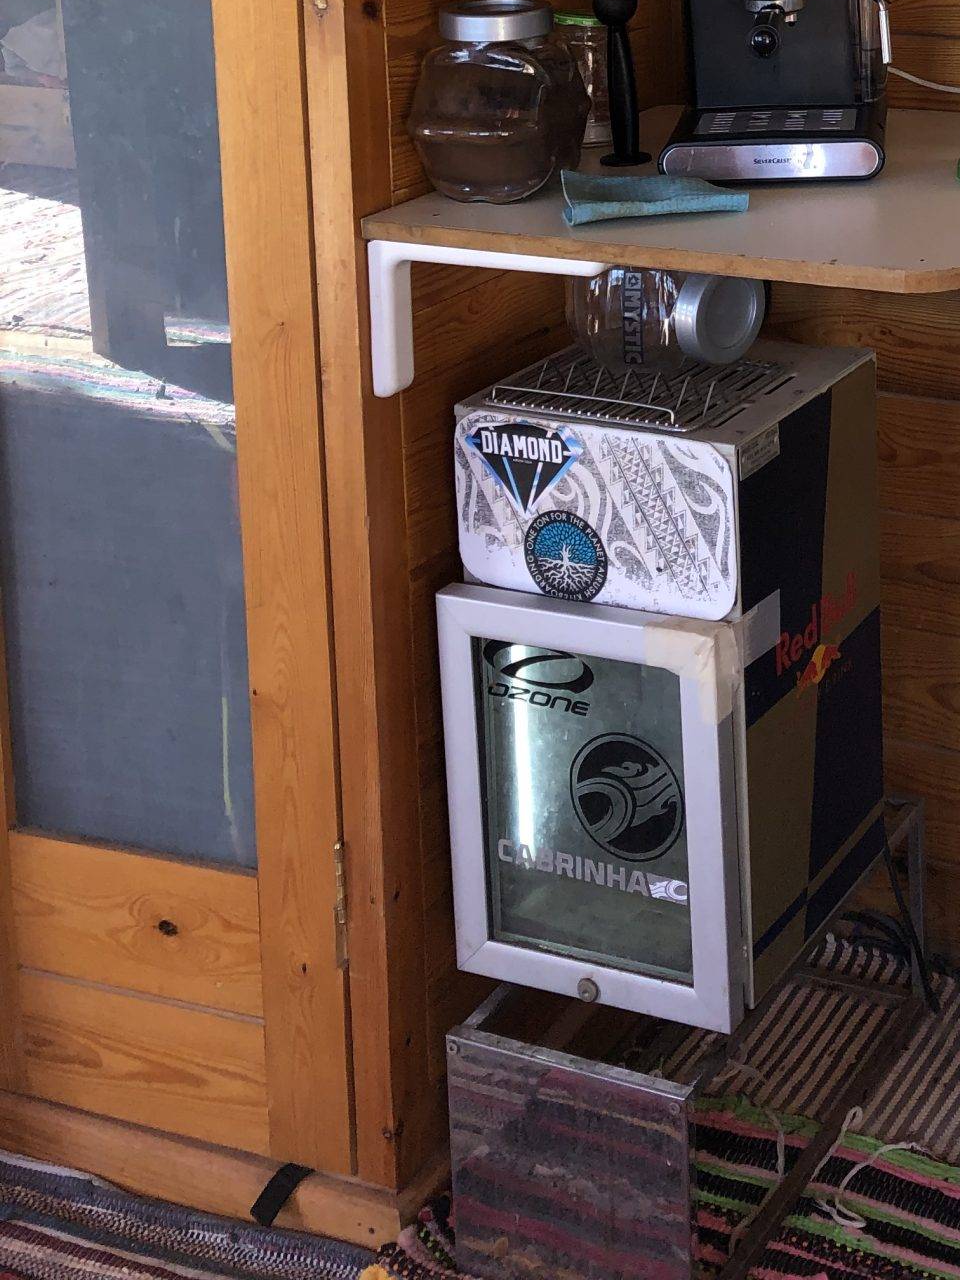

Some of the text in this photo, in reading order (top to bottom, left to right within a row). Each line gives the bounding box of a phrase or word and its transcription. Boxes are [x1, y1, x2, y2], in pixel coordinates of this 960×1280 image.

[623, 289, 643, 365] MYSTIC
[480, 429, 563, 464] DIAMOND
[526, 513, 605, 563] ONE TON FOR THE PLANET
[584, 565, 606, 599] AIRUSH
[775, 603, 818, 677] Red
[487, 681, 591, 717] OZONE
[497, 838, 650, 897] CABRINHA
